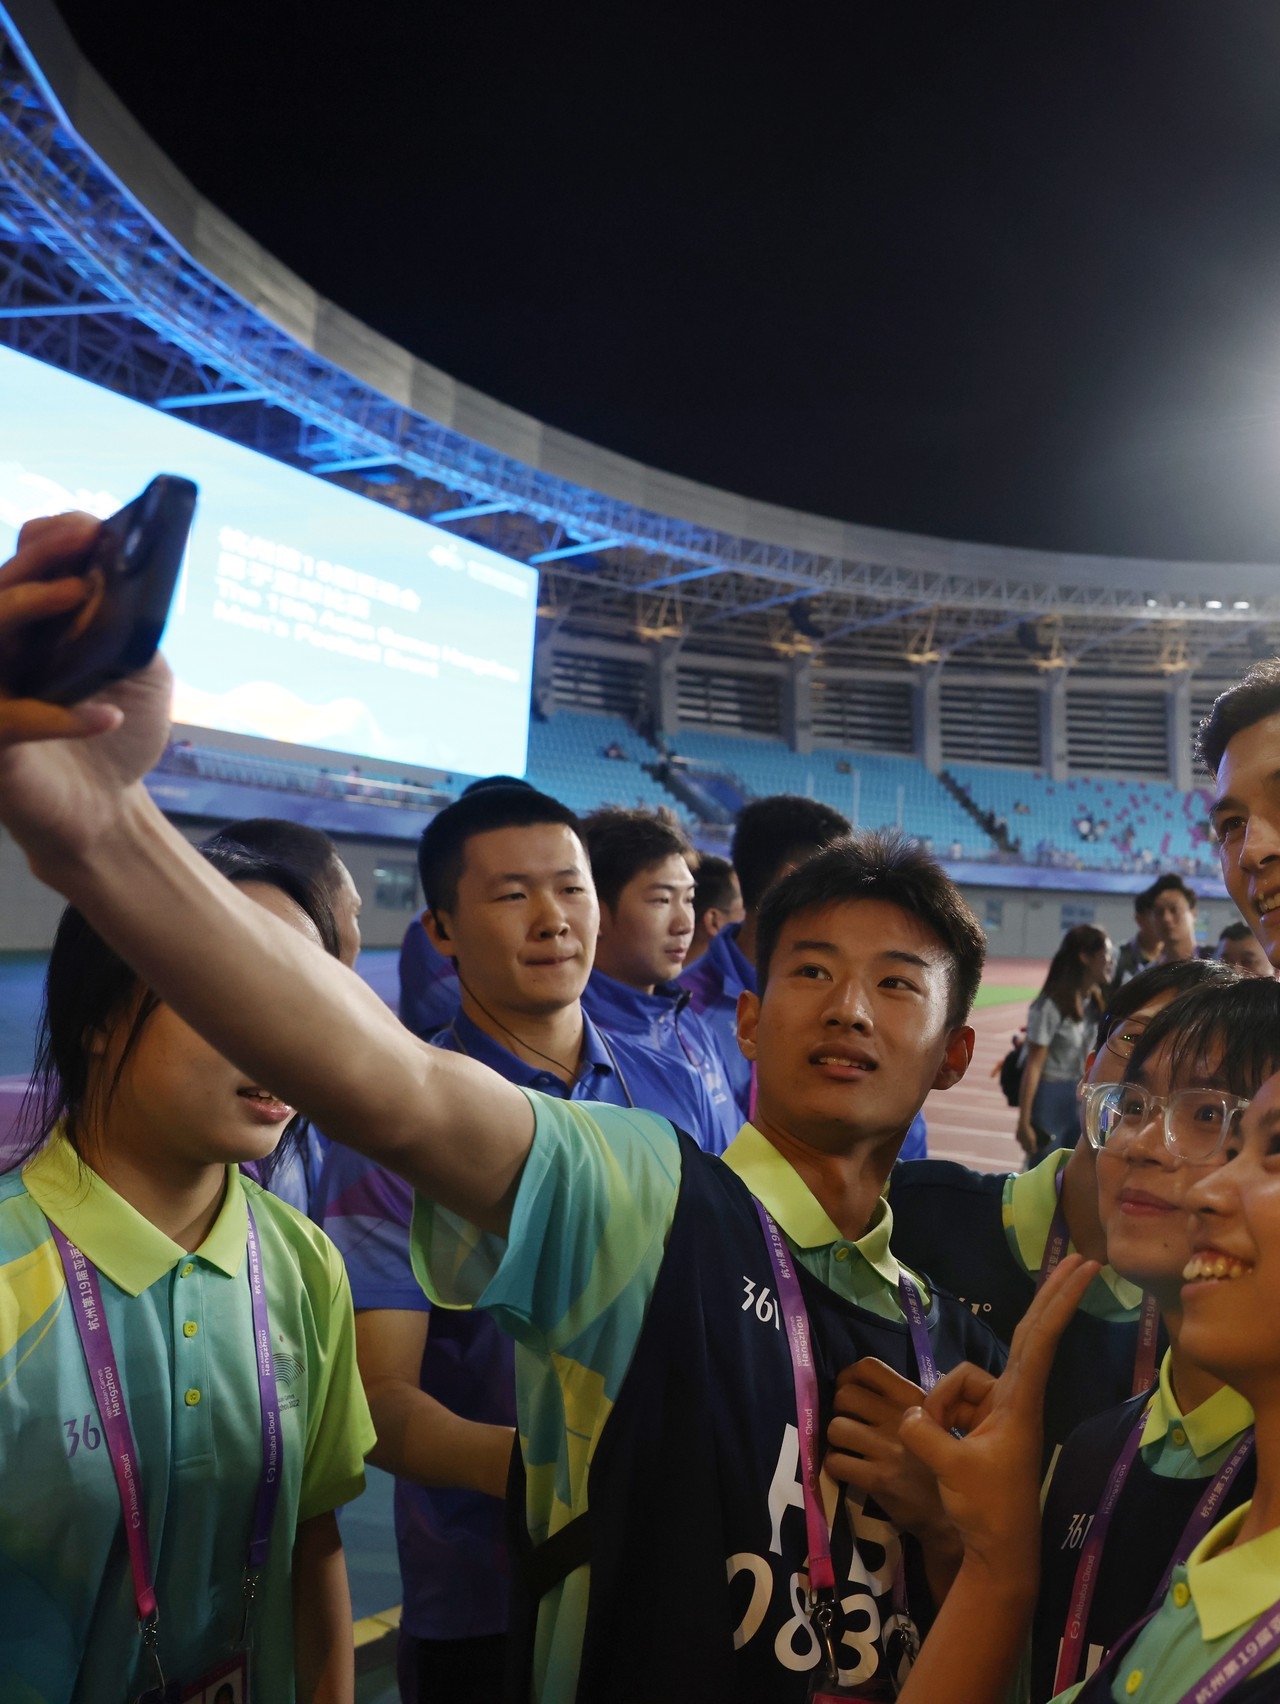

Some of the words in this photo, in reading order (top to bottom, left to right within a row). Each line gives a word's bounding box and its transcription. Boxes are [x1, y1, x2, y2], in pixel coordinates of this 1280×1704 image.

[261, 1329, 270, 1376] Hangzhou
[796, 1315, 810, 1367] Hangzhou
[104, 1366, 121, 1417] Hangzhou
[121, 1453, 132, 1479] Cloud
[269, 1436, 277, 1466] Alibaba
[127, 1478, 139, 1511] Alibaba
[1060, 1513, 1096, 1550] 361
[1081, 1555, 1095, 1583] Cloud
[1076, 1582, 1088, 1619] Alibaba
